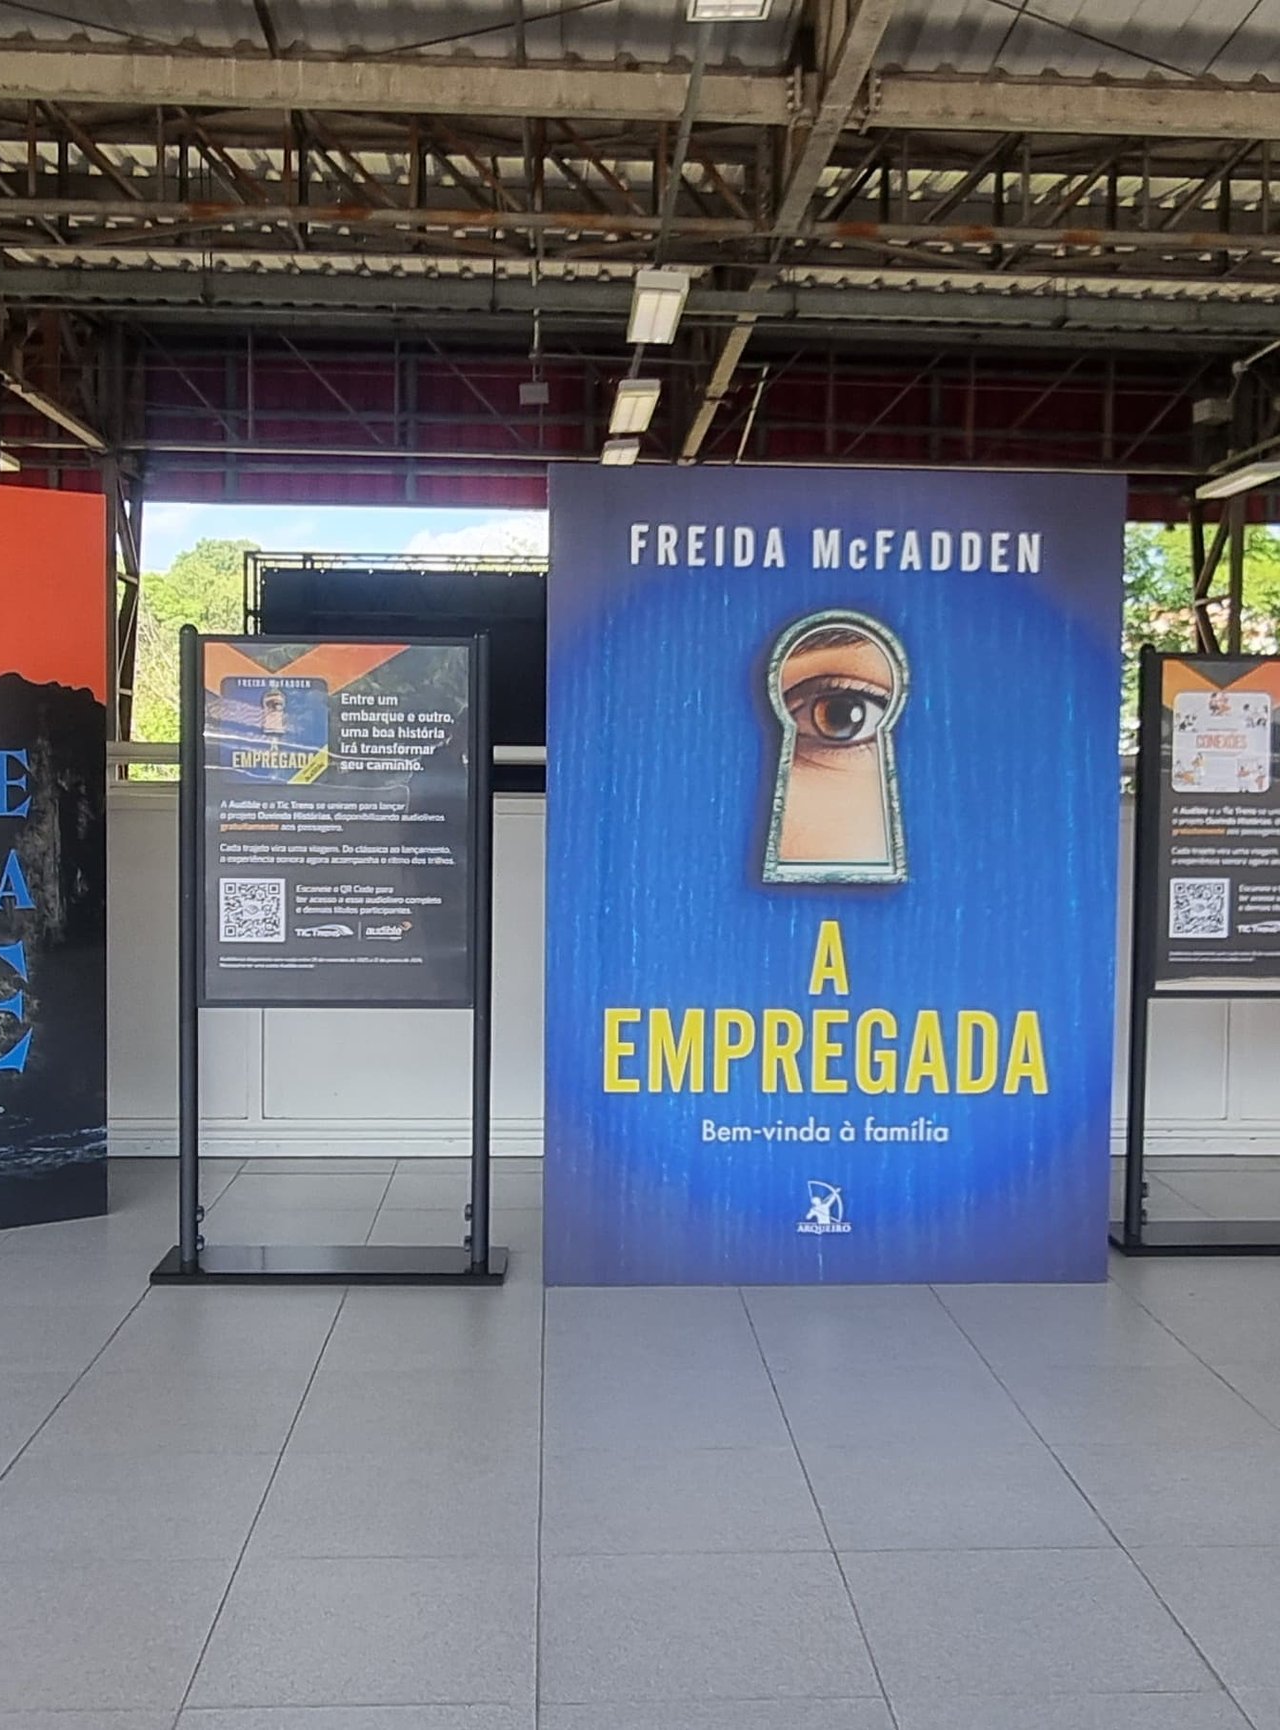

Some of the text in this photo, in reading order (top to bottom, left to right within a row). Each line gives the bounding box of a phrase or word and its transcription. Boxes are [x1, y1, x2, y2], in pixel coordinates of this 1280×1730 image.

[630, 524, 1042, 574] FREIDA McFADDEN
[341, 693, 398, 706] Entre um
[341, 710, 455, 724] embarque e outro,
[341, 726, 445, 739] uma boa história
[341, 742, 436, 755] irá transformar
[340, 759, 424, 771] seu caminho.
[809, 920, 849, 995] A
[603, 1008, 1049, 1096] EMPREGADA
[702, 1116, 949, 1142] Bem-vinda à família
